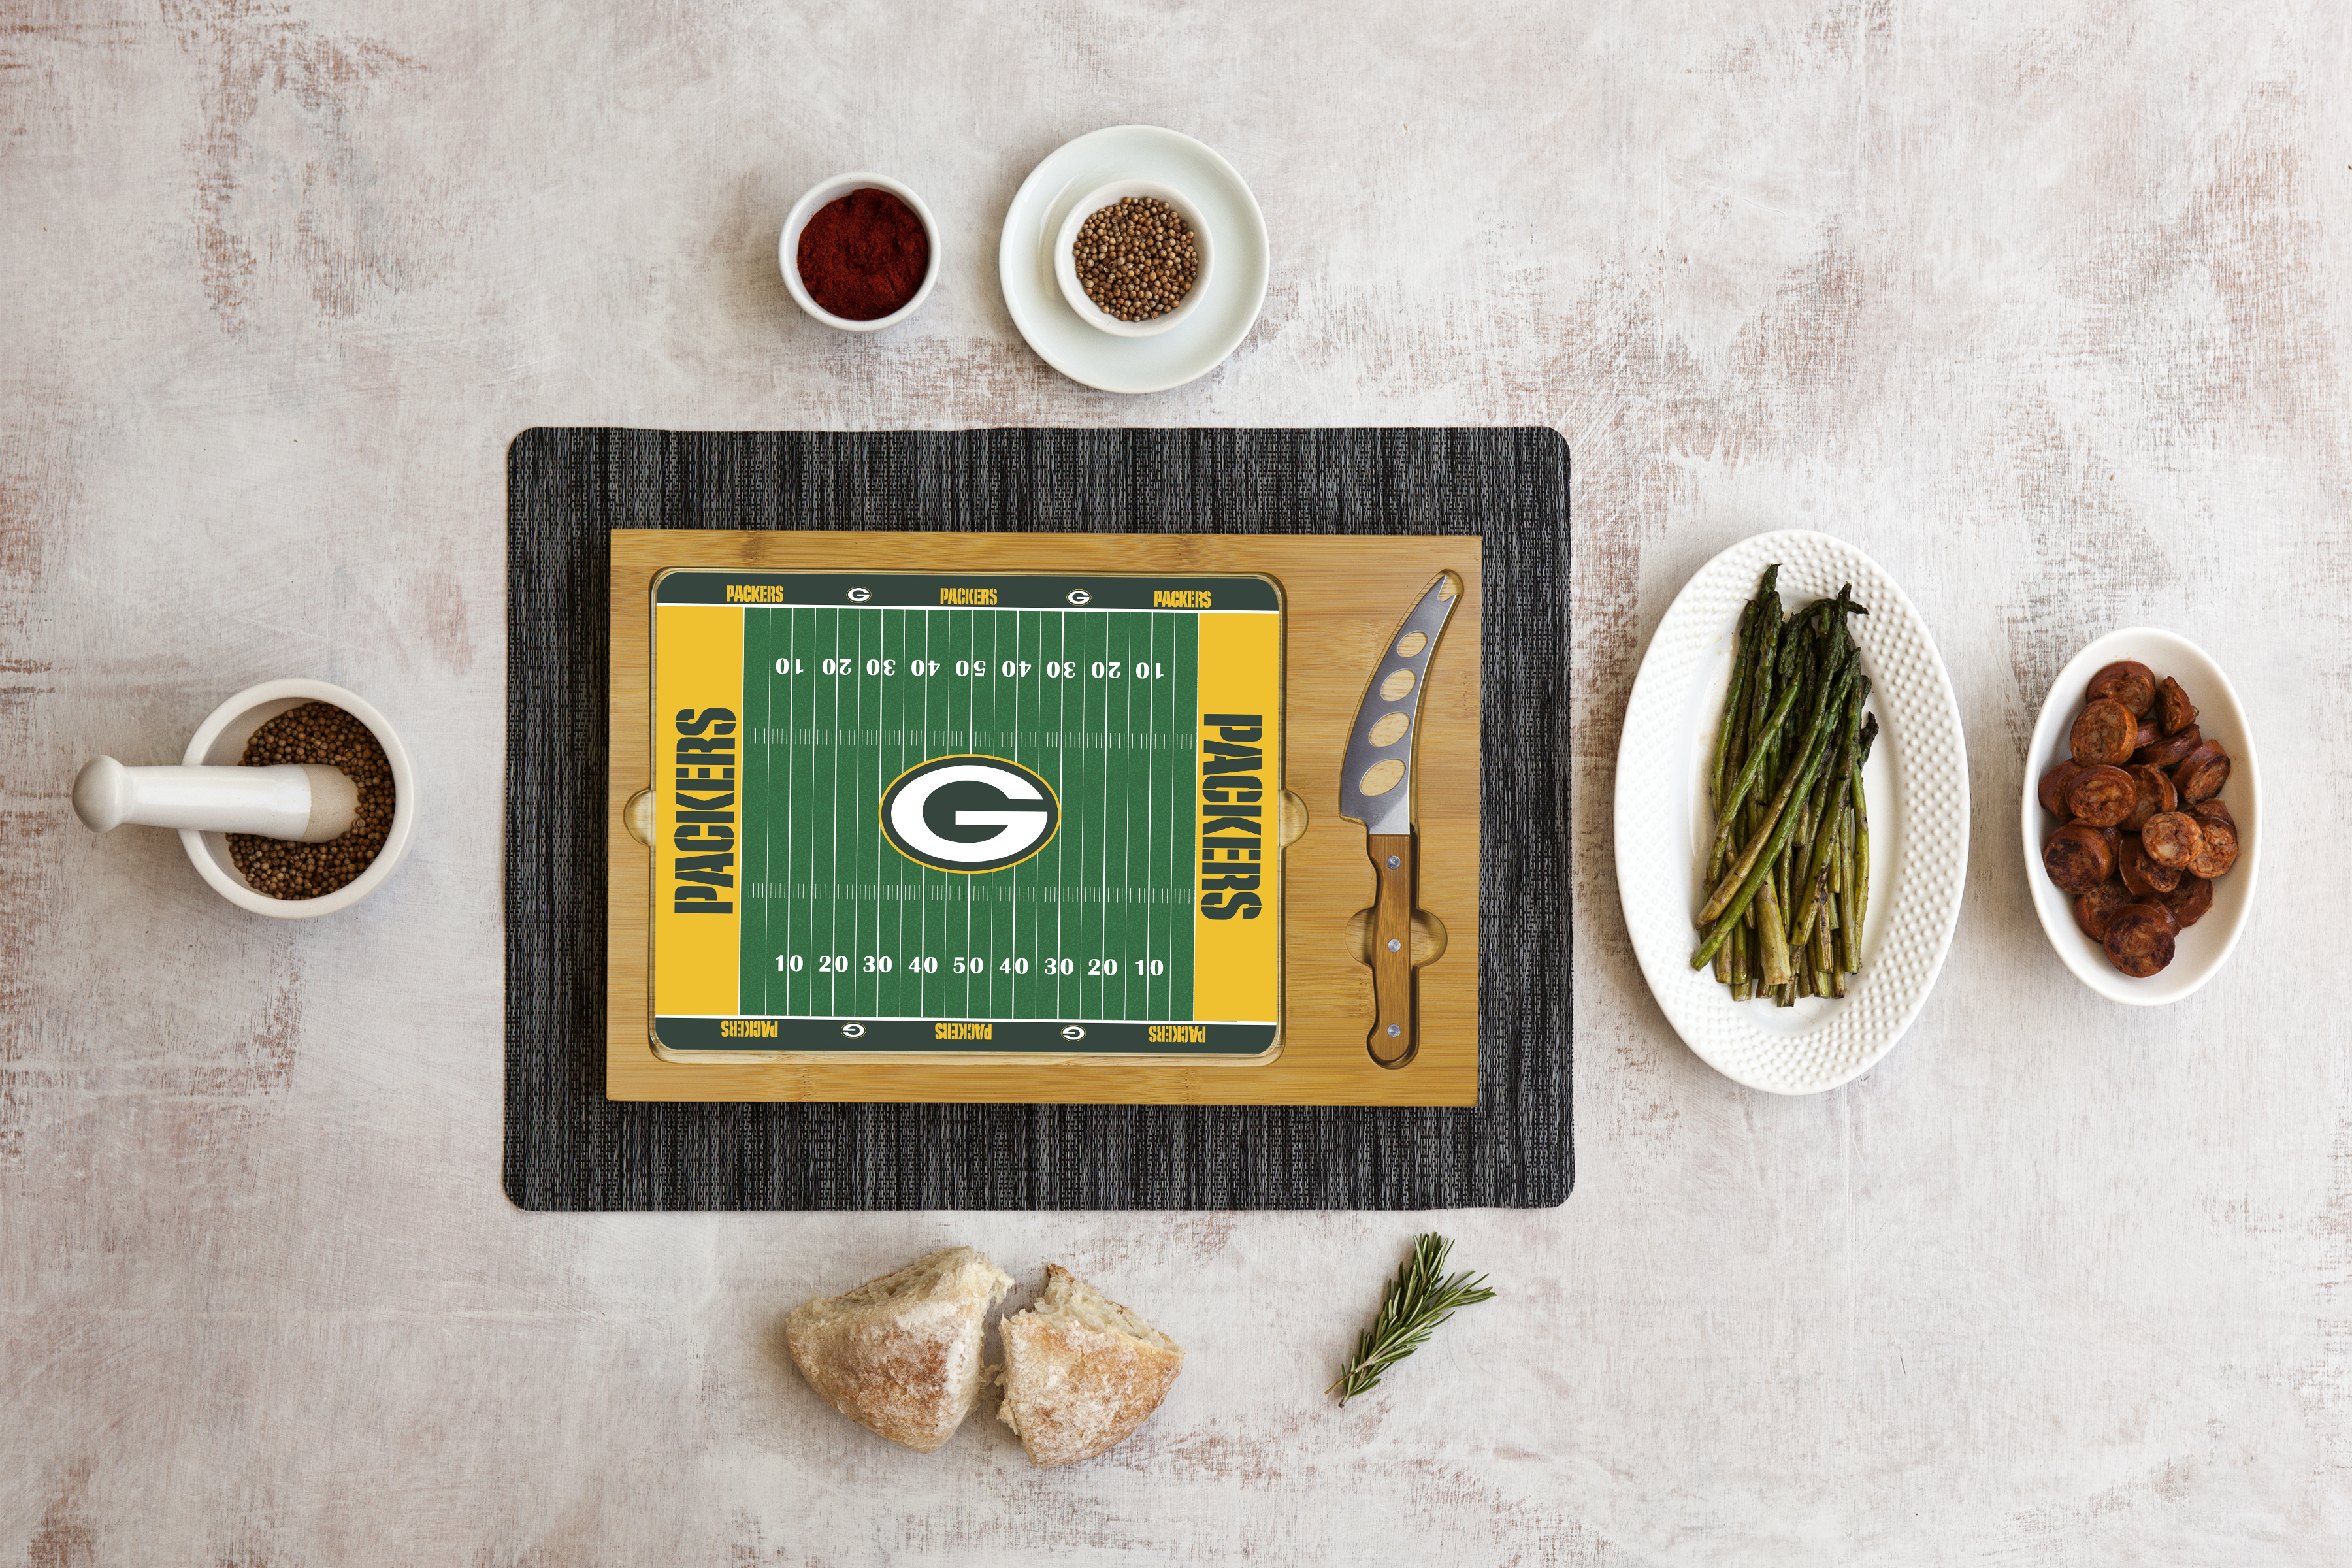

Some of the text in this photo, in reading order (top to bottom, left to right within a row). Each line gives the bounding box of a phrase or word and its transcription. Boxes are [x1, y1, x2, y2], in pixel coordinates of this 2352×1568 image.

[725, 584, 785, 603] PACKERS
[847, 587, 871, 602] G
[939, 587, 998, 606] PACKERS
[1067, 589, 1090, 605] G
[1153, 589, 1212, 609] PACKERS
[775, 657, 1165, 680] 10 20 30 40 50 40 30 20 10
[674, 708, 737, 915] PACKERS
[890, 764, 1049, 863] G
[1200, 713, 1264, 921] PACKERS
[774, 954, 1164, 977] 10 20 30 40 50 40 30 20 10
[720, 1019, 779, 1038] PACKERS
[841, 1022, 866, 1038] G
[934, 1022, 992, 1041] PACKERS
[1062, 1025, 1085, 1041] G
[1148, 1024, 1207, 1044] PACKERS
